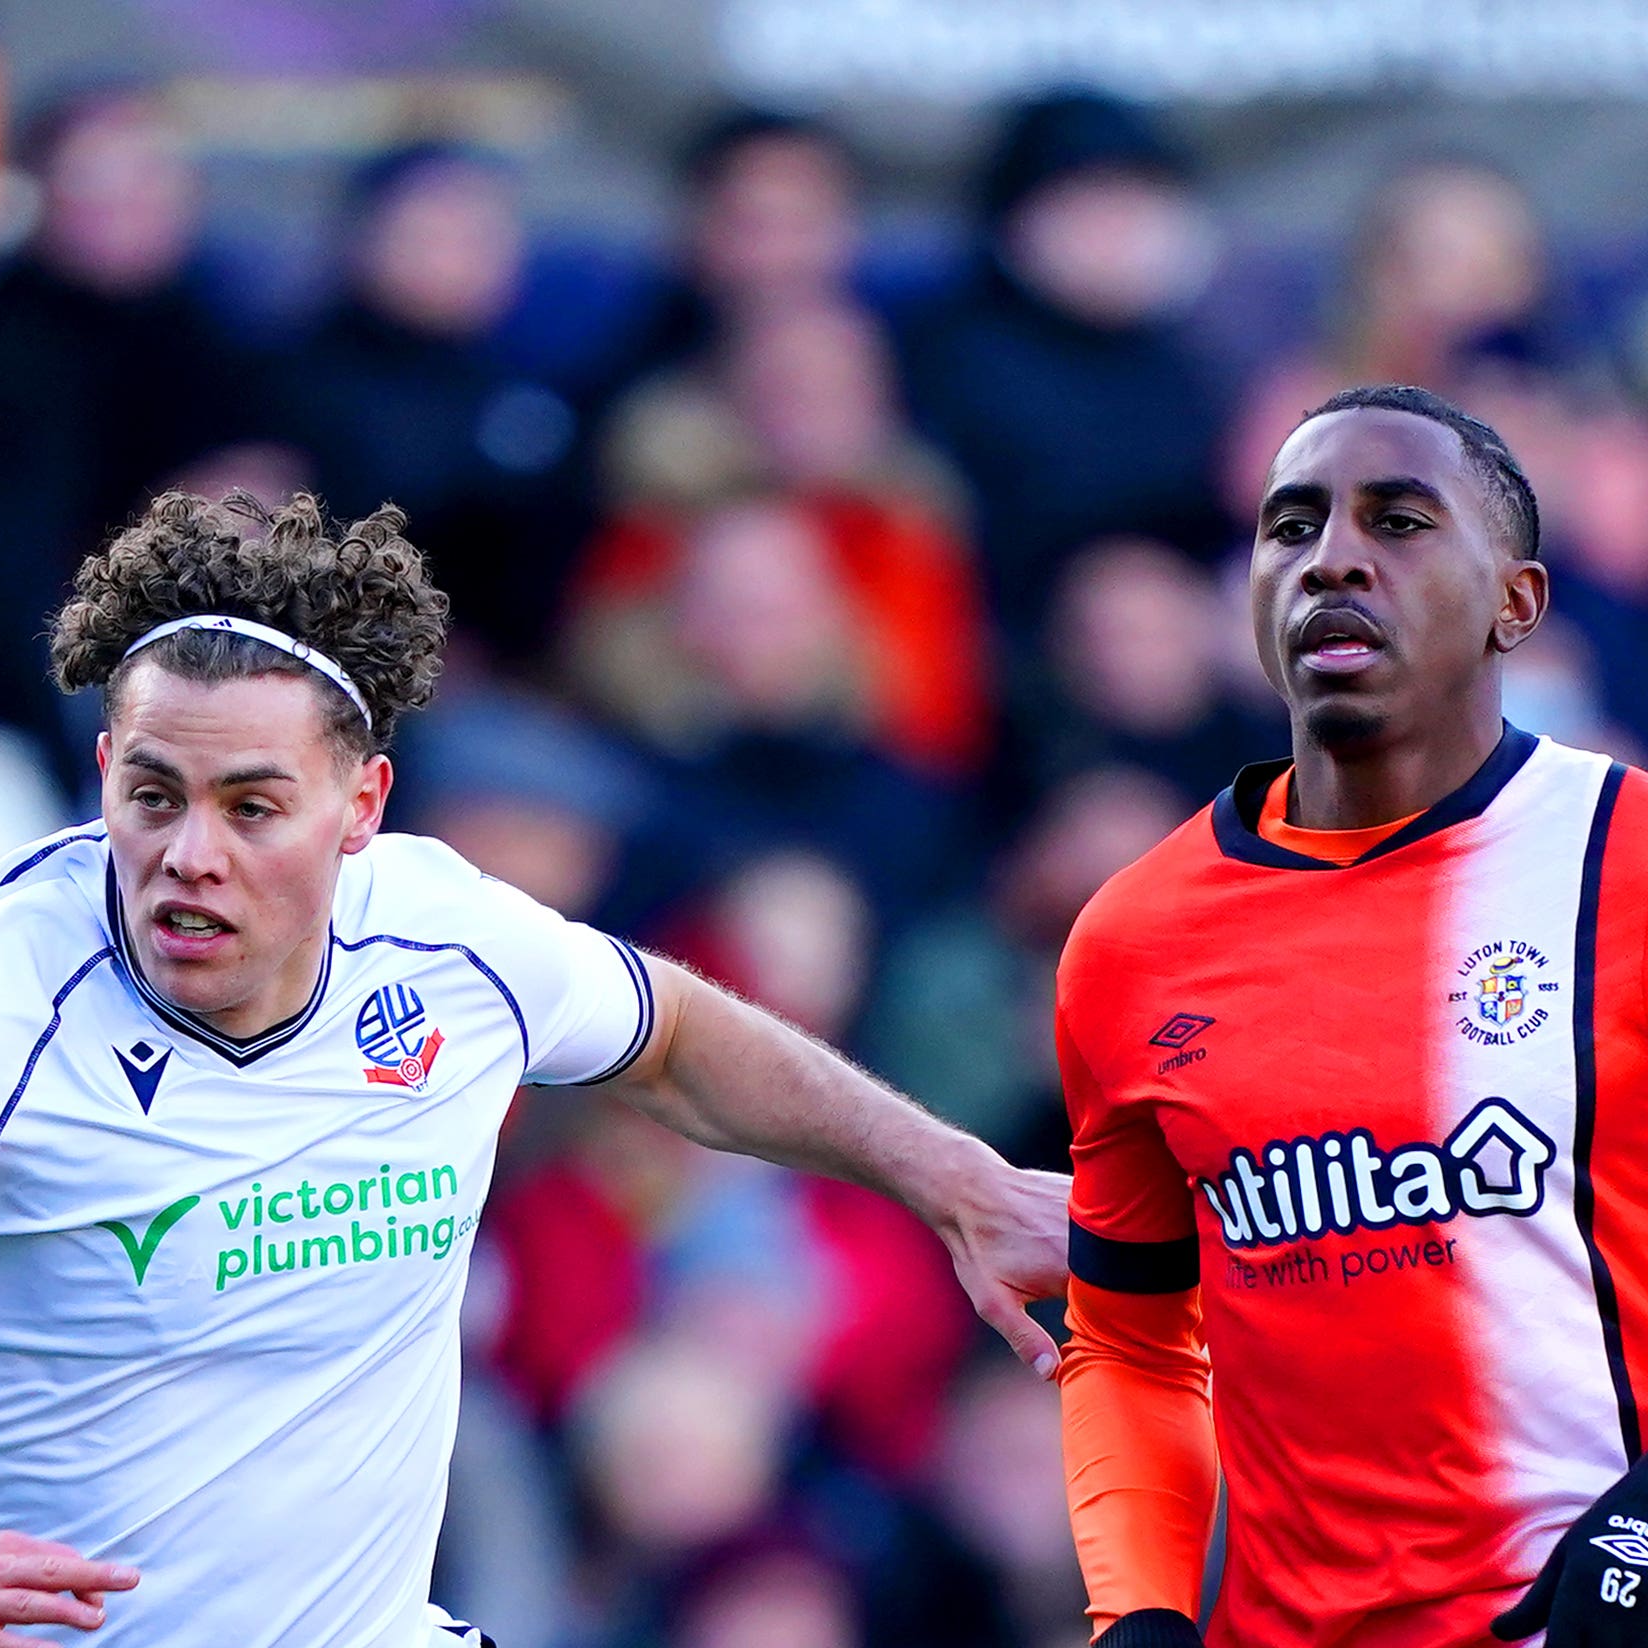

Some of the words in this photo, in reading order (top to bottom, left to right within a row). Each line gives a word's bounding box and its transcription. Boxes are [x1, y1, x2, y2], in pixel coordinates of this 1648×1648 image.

[1457, 940, 1503, 976] LUTON
[1509, 939, 1550, 969] TOWN
[1455, 1016, 1515, 1046] FOOTBALL
[1517, 1008, 1549, 1039] CLUB
[1158, 1048, 1206, 1075] umbro
[218, 1163, 458, 1231] victorian
[1203, 1135, 1451, 1241] utilita
[1262, 1246, 1329, 1287] with
[1341, 1237, 1457, 1288] power
[1600, 1566, 1642, 1608] 29
